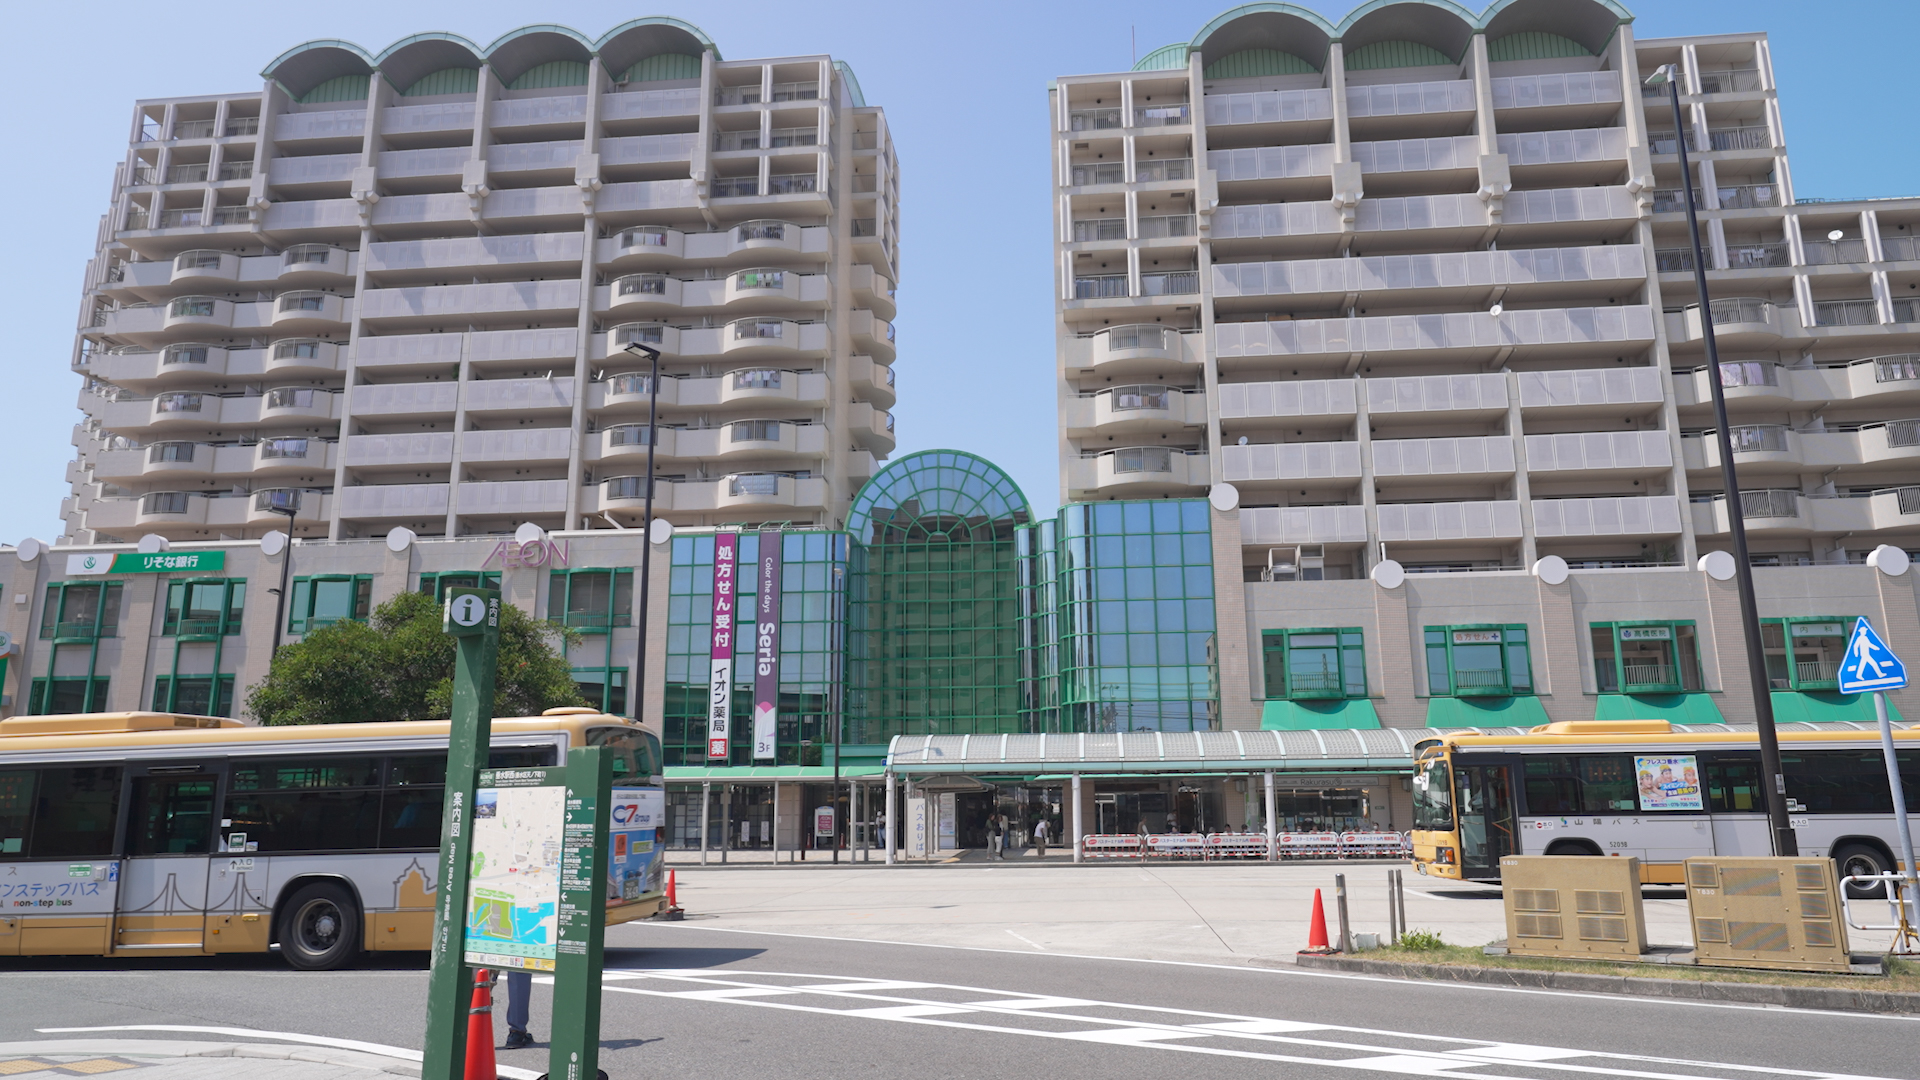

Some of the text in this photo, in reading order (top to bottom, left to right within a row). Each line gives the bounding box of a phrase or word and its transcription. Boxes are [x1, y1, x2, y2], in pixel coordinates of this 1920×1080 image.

[143, 555, 199, 569] りそな銀行
[480, 540, 569, 568] AEON
[761, 557, 773, 614] Color the days
[714, 545, 733, 648] 処方せん受付
[488, 597, 499, 627] 案内図
[1455, 633, 1490, 641] 処方せん
[758, 622, 776, 676] Seria
[712, 667, 728, 733] イオン薬局
[711, 740, 726, 755] 薬
[757, 742, 771, 753] 3F
[1300, 778, 1334, 787] Rakurasu
[450, 791, 464, 838] 案内図
[634, 814, 651, 823] Group
[915, 803, 925, 852] バスおりば
[238, 858, 253, 866] 入口
[445, 842, 457, 892] Area Map
[7, 866, 18, 876] ス
[0, 882, 100, 898] ンステップバス
[13, 898, 54, 908] non-step
[56, 898, 73, 906] bus
